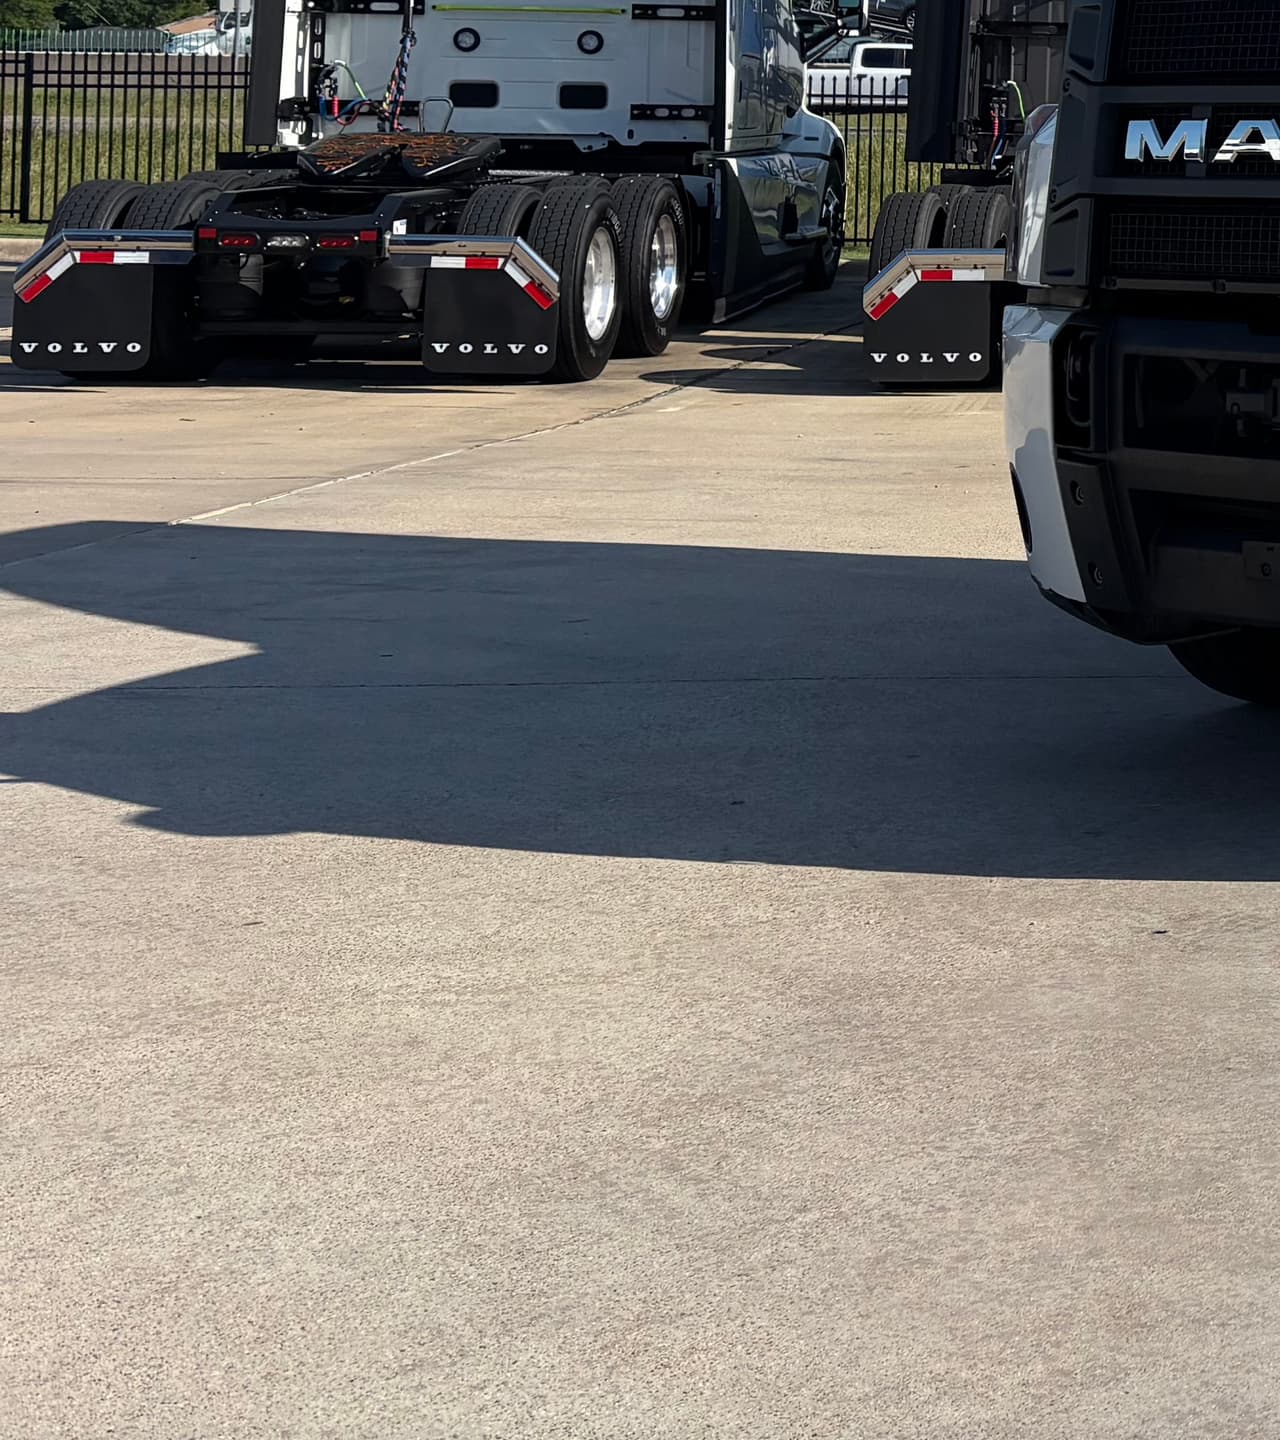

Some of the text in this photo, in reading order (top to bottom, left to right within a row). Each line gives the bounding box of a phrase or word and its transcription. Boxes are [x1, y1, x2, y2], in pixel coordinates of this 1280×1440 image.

[19, 342, 142, 353] VOLVO
[431, 342, 549, 354] VOLVO
[869, 352, 982, 363] VOLVO
